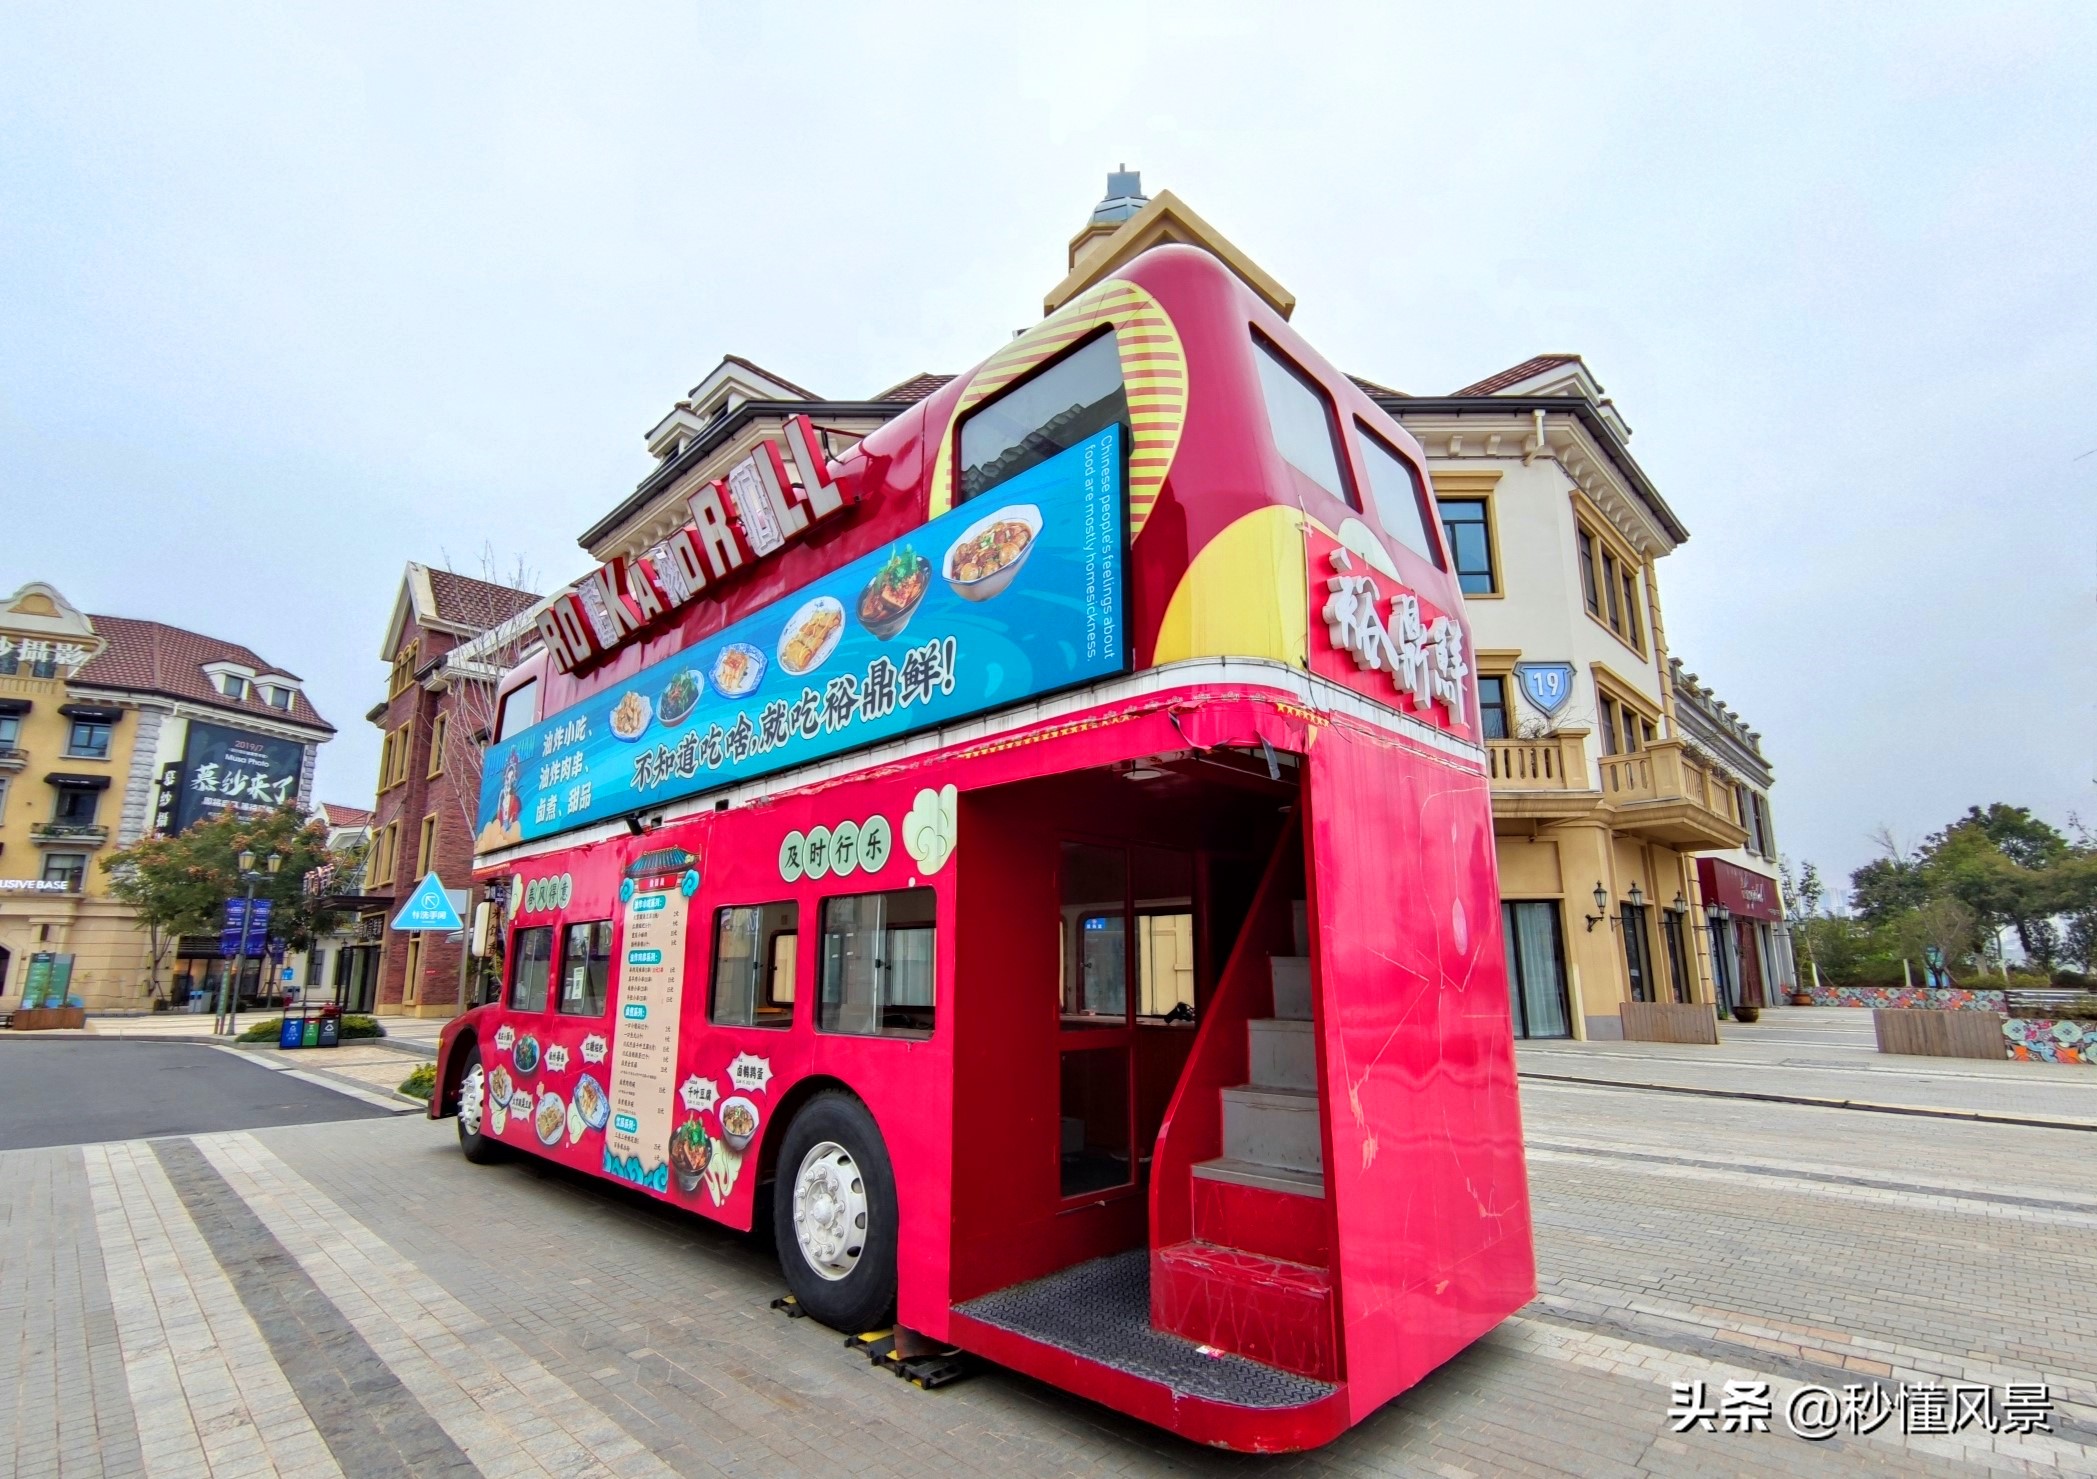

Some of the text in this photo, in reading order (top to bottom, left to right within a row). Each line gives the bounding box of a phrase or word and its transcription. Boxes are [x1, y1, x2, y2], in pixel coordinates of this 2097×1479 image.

[1083, 444, 1097, 662] food are mostly homesickness.
[1099, 434, 1115, 659] Chinese people's feelings about
[1532, 671, 1560, 697] 19
[224, 753, 247, 764] Musa
[247, 757, 270, 768] Photo
[784, 828, 883, 869] 及时行乐
[36, 880, 69, 890] BASE
[688, 1086, 712, 1101] 千叶豆腐
